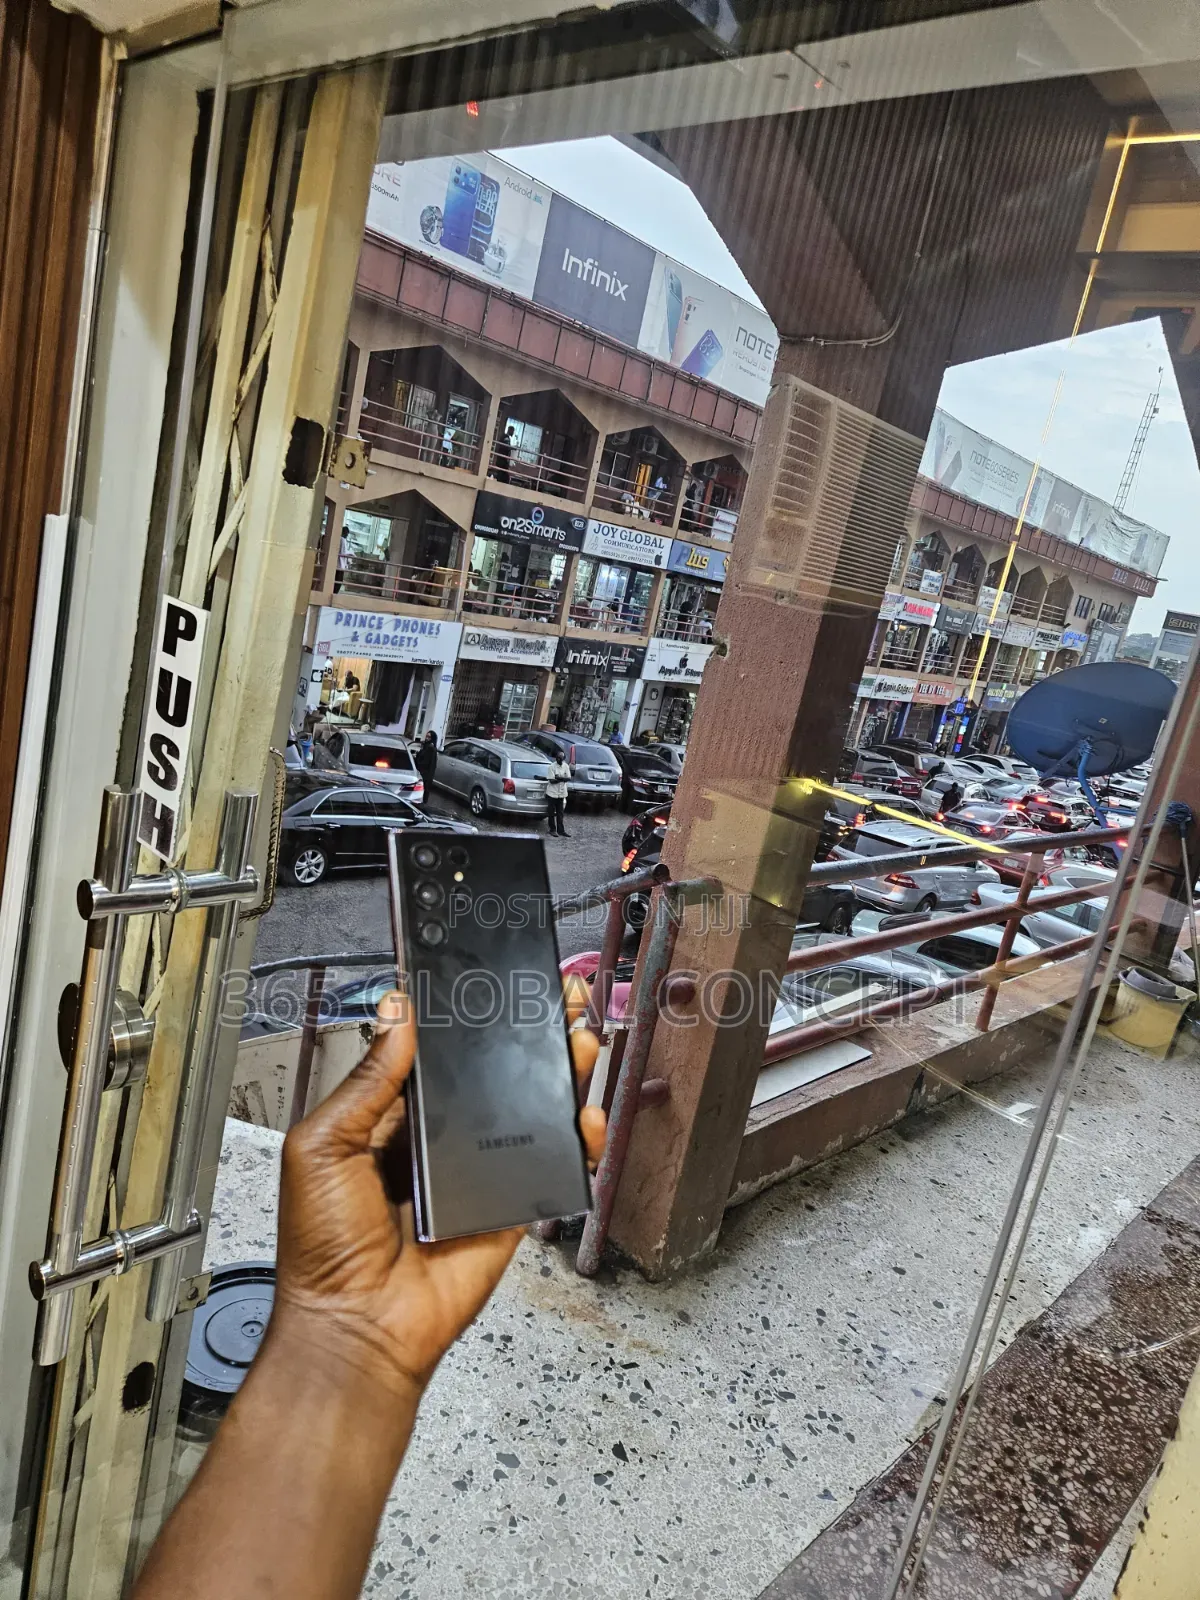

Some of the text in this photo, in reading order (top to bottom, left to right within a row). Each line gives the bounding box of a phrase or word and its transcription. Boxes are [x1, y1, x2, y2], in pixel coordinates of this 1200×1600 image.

[503, 177, 533, 200] Android
[561, 247, 629, 302] Infinix
[593, 523, 665, 549] JOY GLOBAL
[603, 538, 656, 554] COMMUNICATIONS
[334, 611, 442, 636] PRINCE PHONES
[350, 631, 360, 643] &
[364, 632, 419, 649] GADGETS
[480, 645, 503, 654] Clothing
[509, 648, 541, 656] Accessories
[567, 649, 608, 667] Infinix
[684, 666, 703, 678] Stor
[138, 602, 198, 860] PUSH
